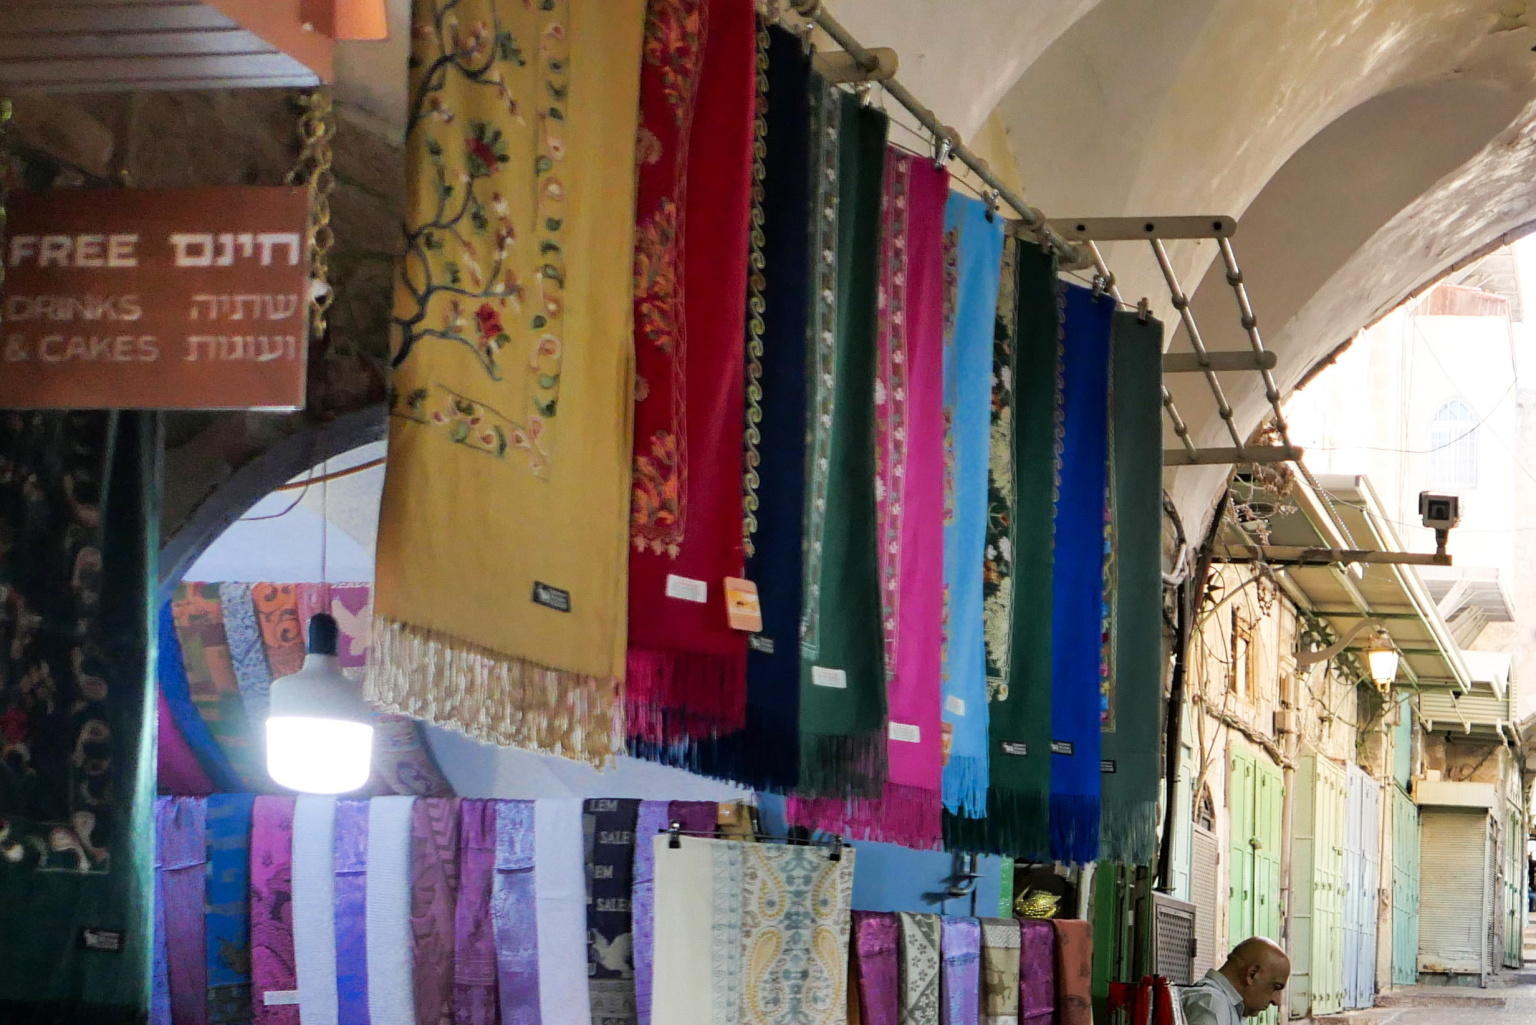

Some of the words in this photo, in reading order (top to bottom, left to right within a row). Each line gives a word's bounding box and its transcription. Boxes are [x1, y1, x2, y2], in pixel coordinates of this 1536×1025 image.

[8, 233, 139, 268] FREE
[168, 231, 300, 267] חינם
[6, 294, 143, 322] DRINKS
[189, 293, 299, 322] שתיה
[38, 335, 161, 362] CAKES
